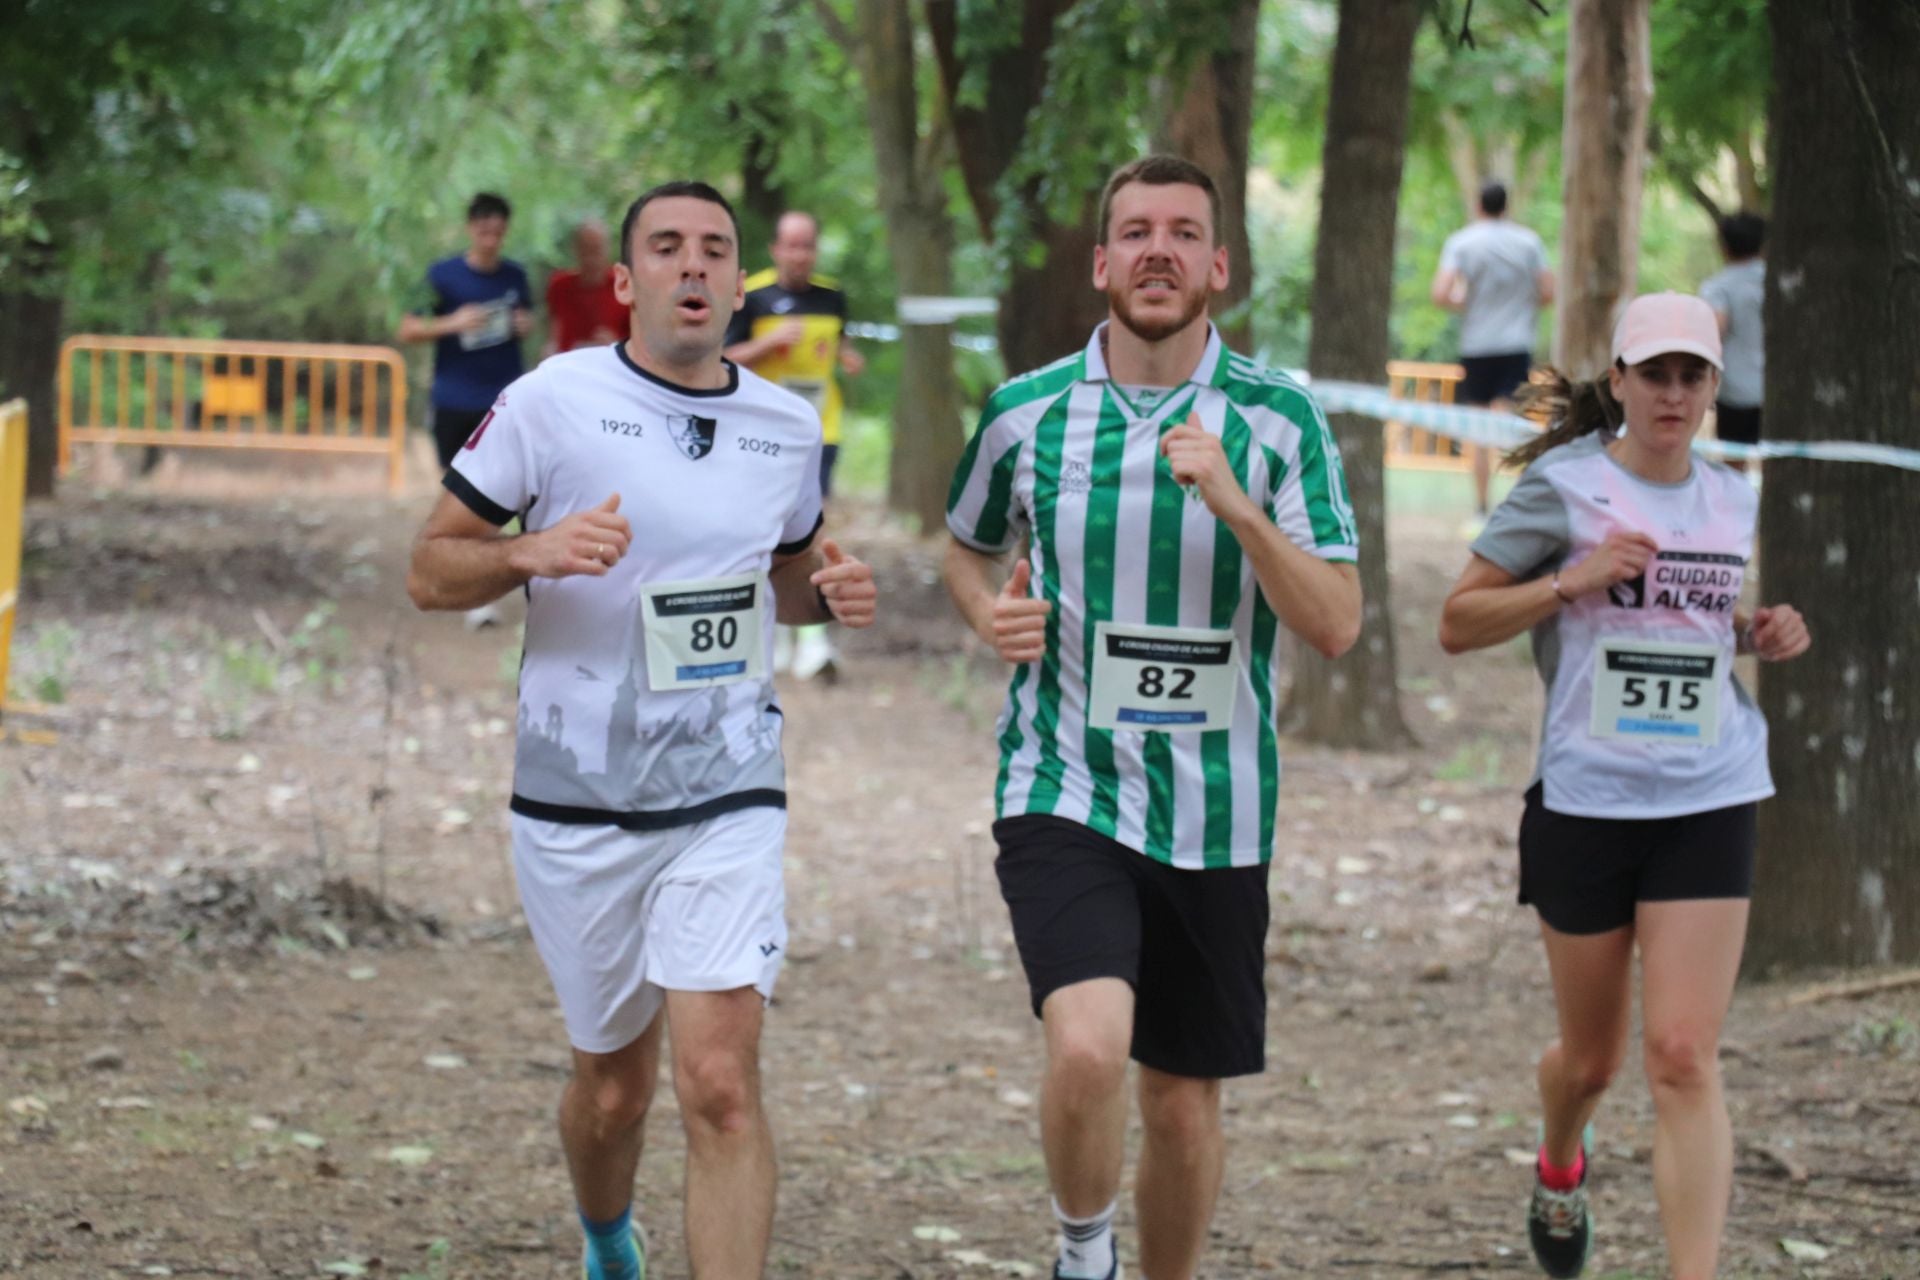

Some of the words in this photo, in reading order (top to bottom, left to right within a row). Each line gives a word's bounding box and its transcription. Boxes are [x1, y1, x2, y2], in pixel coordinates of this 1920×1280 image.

[600, 419, 643, 437] 1922
[738, 437, 781, 457] 2022
[1656, 566, 1732, 587] CIUDAD
[691, 616, 738, 653] 80
[1137, 666, 1196, 699] 82
[1622, 677, 1700, 710] 515
